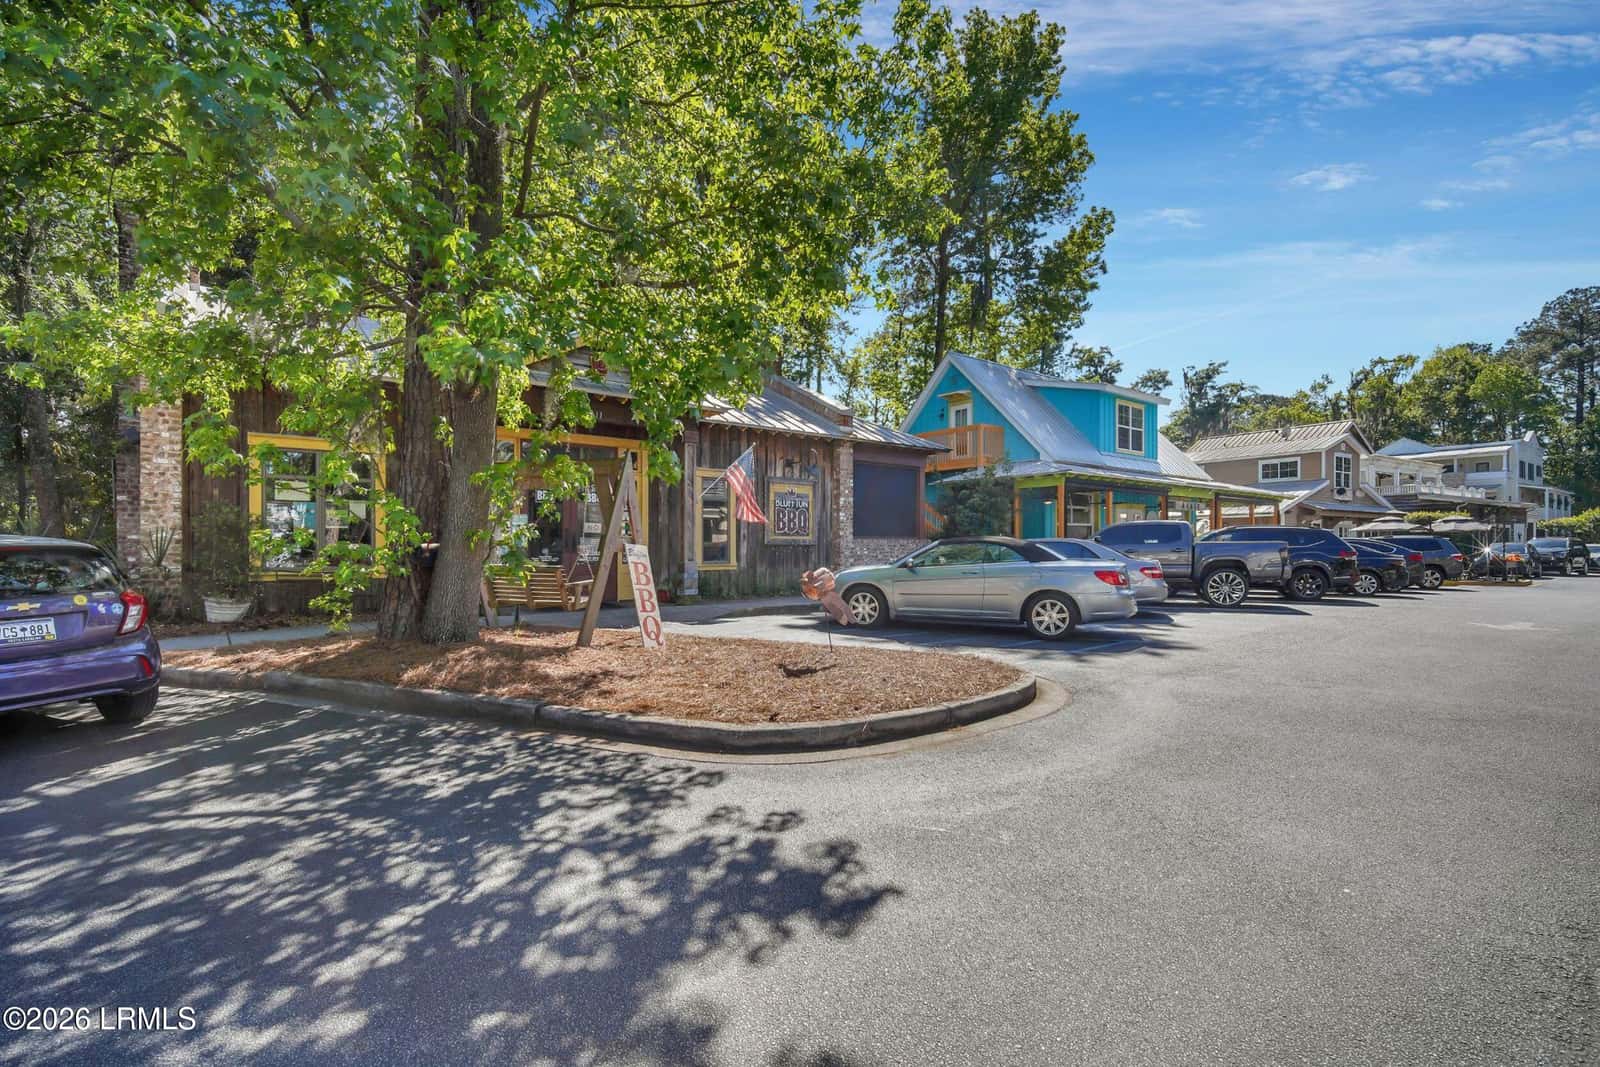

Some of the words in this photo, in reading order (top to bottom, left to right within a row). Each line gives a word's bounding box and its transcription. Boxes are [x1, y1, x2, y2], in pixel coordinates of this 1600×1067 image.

[775, 507, 809, 535] BBQ
[631, 561, 664, 646] BBQ
[0, 626, 18, 638] CS
[29, 624, 51, 636] 881
